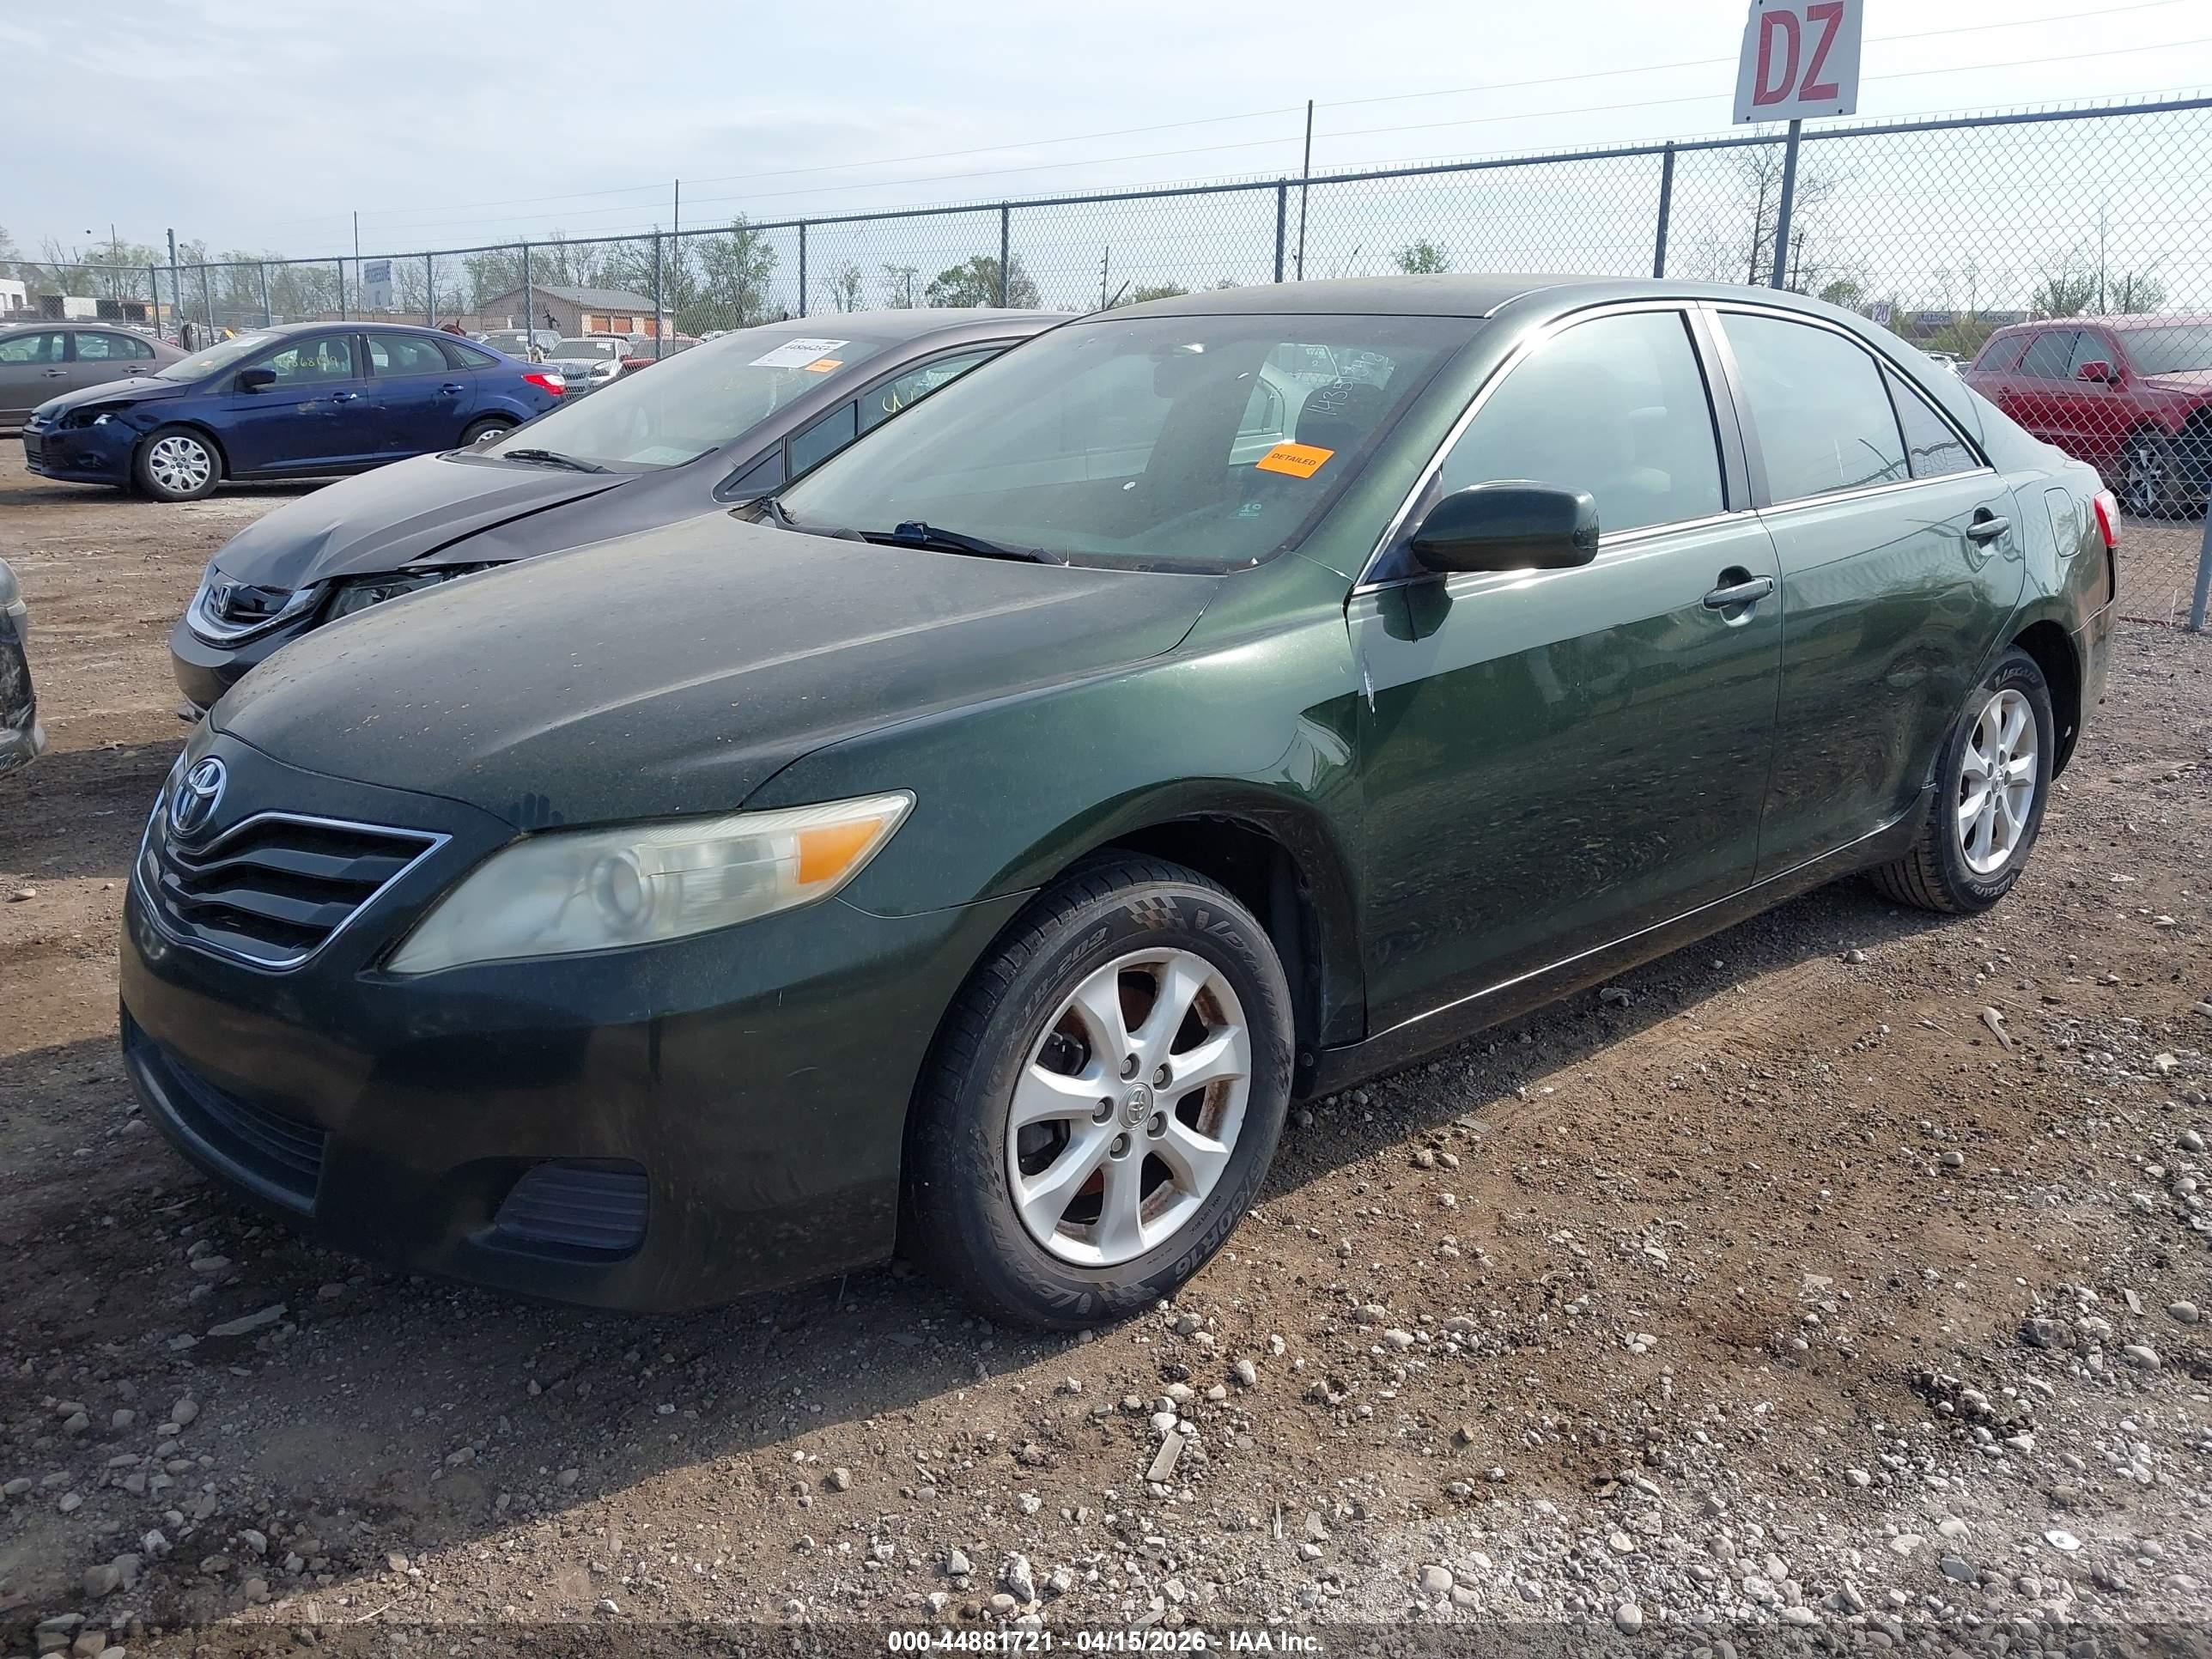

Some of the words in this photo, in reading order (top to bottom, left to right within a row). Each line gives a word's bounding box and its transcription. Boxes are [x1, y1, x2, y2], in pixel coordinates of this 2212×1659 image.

[1753, 1, 1844, 106] DZ
[1875, 304, 1889, 322] 20
[1270, 452, 1317, 467] DETAILED
